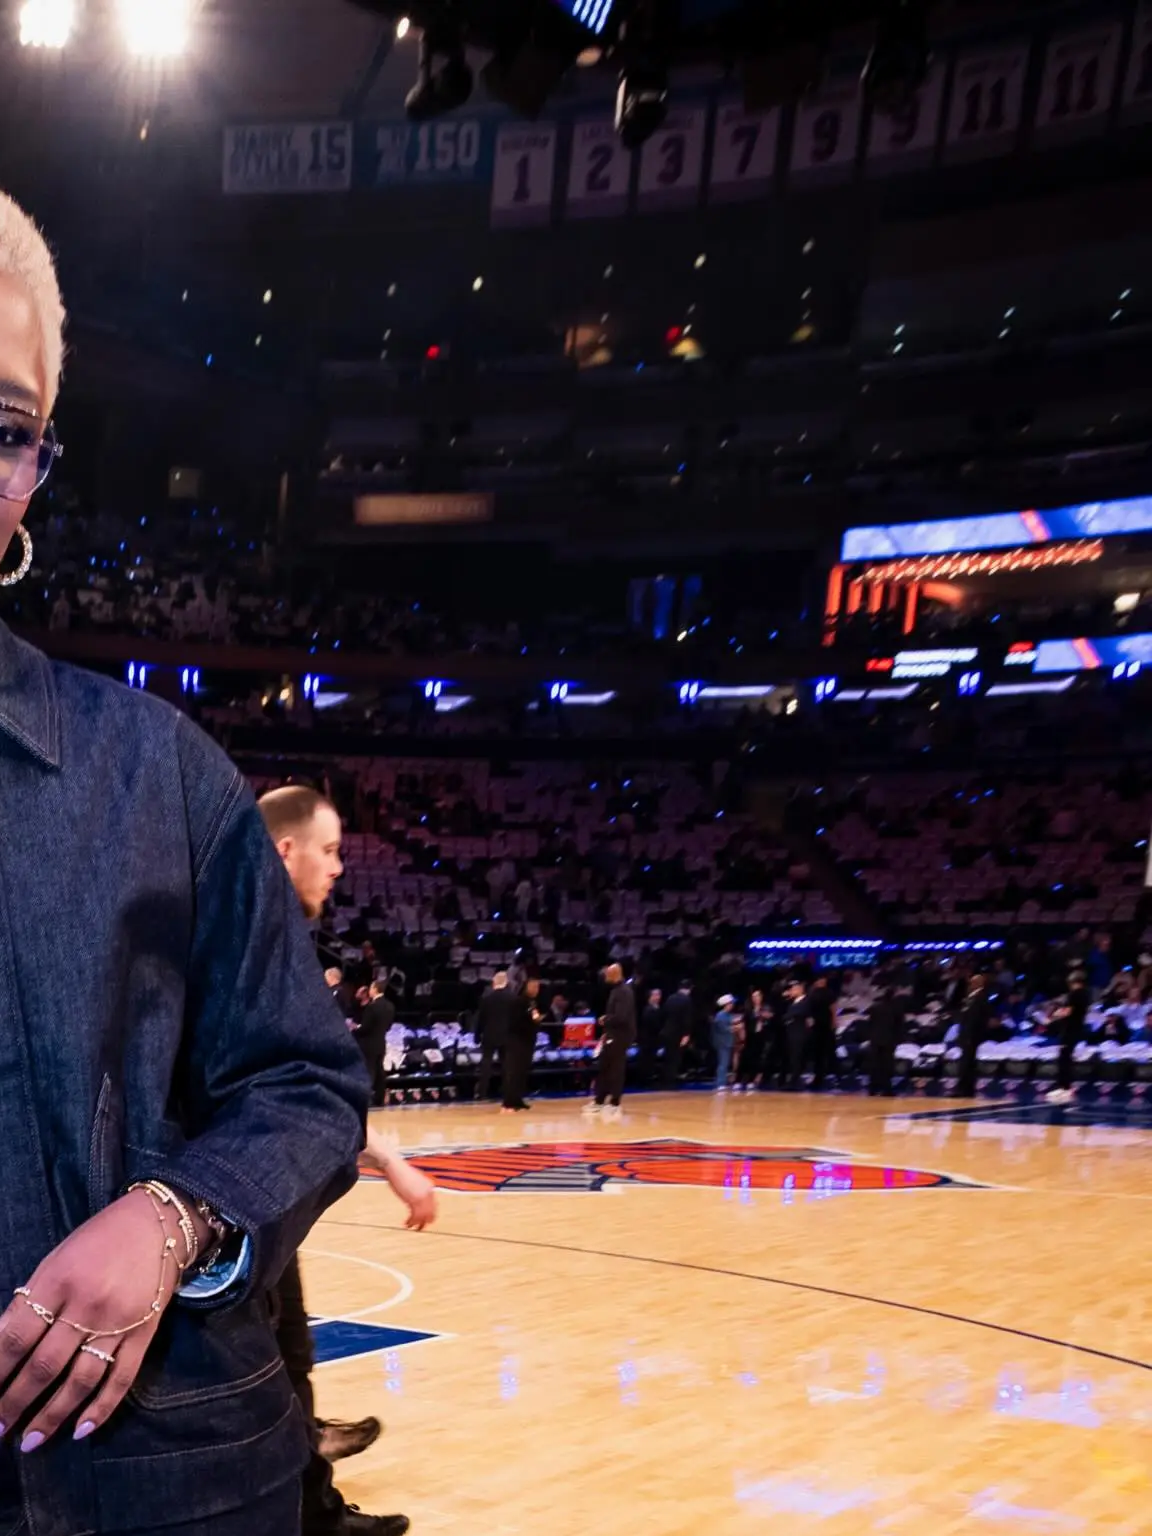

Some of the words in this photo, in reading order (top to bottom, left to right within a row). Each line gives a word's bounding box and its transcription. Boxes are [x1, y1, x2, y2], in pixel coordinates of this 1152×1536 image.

[959, 77, 1007, 134] 11
[1050, 57, 1099, 118] 11
[309, 127, 346, 171] 15
[413, 121, 480, 170] 150
[657, 134, 685, 185] 3
[730, 125, 761, 175] 7
[812, 110, 841, 162] 9
[512, 153, 531, 203] 1
[585, 144, 613, 191] 2
